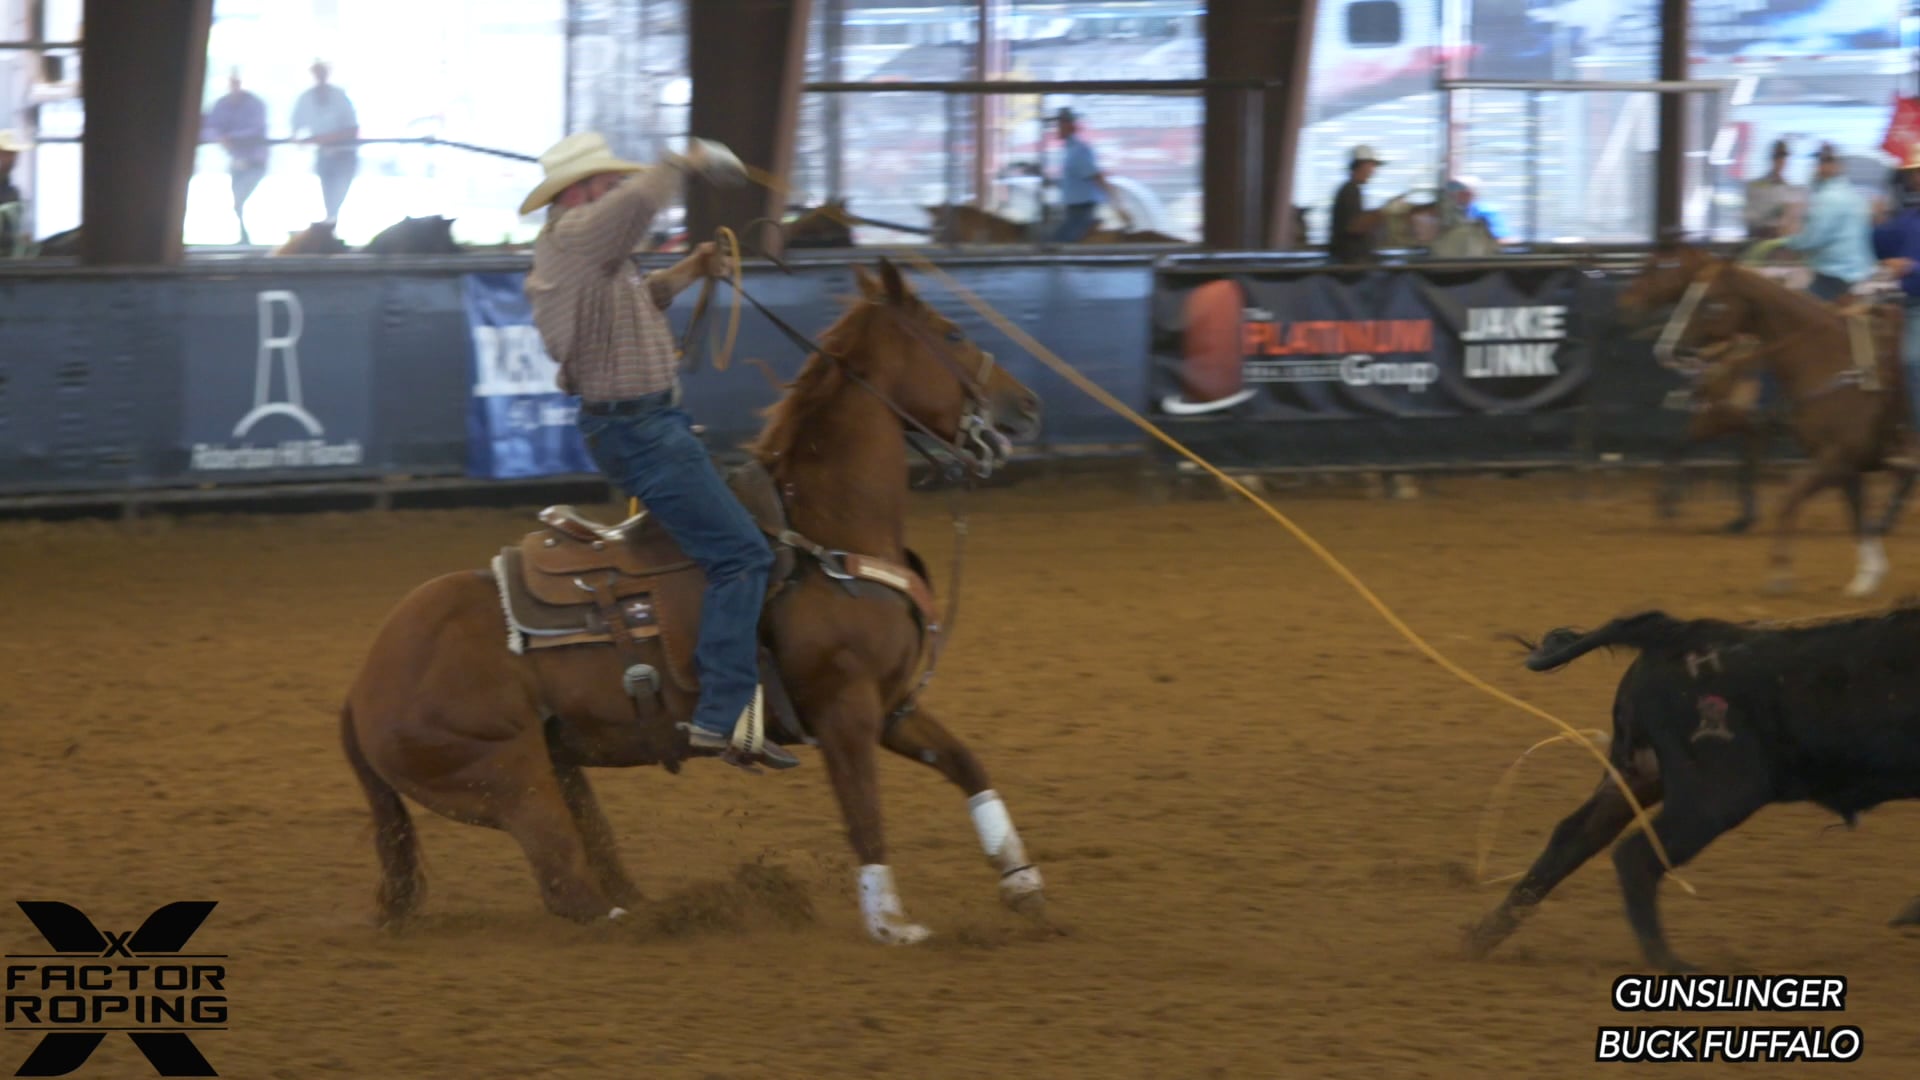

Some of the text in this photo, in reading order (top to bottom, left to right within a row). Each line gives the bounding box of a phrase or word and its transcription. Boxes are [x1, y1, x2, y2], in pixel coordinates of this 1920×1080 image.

[1242, 320, 1433, 354] PLATINUM
[1460, 306, 1567, 340] JAKE
[1340, 354, 1439, 393] Group
[1464, 343, 1559, 378] LINK
